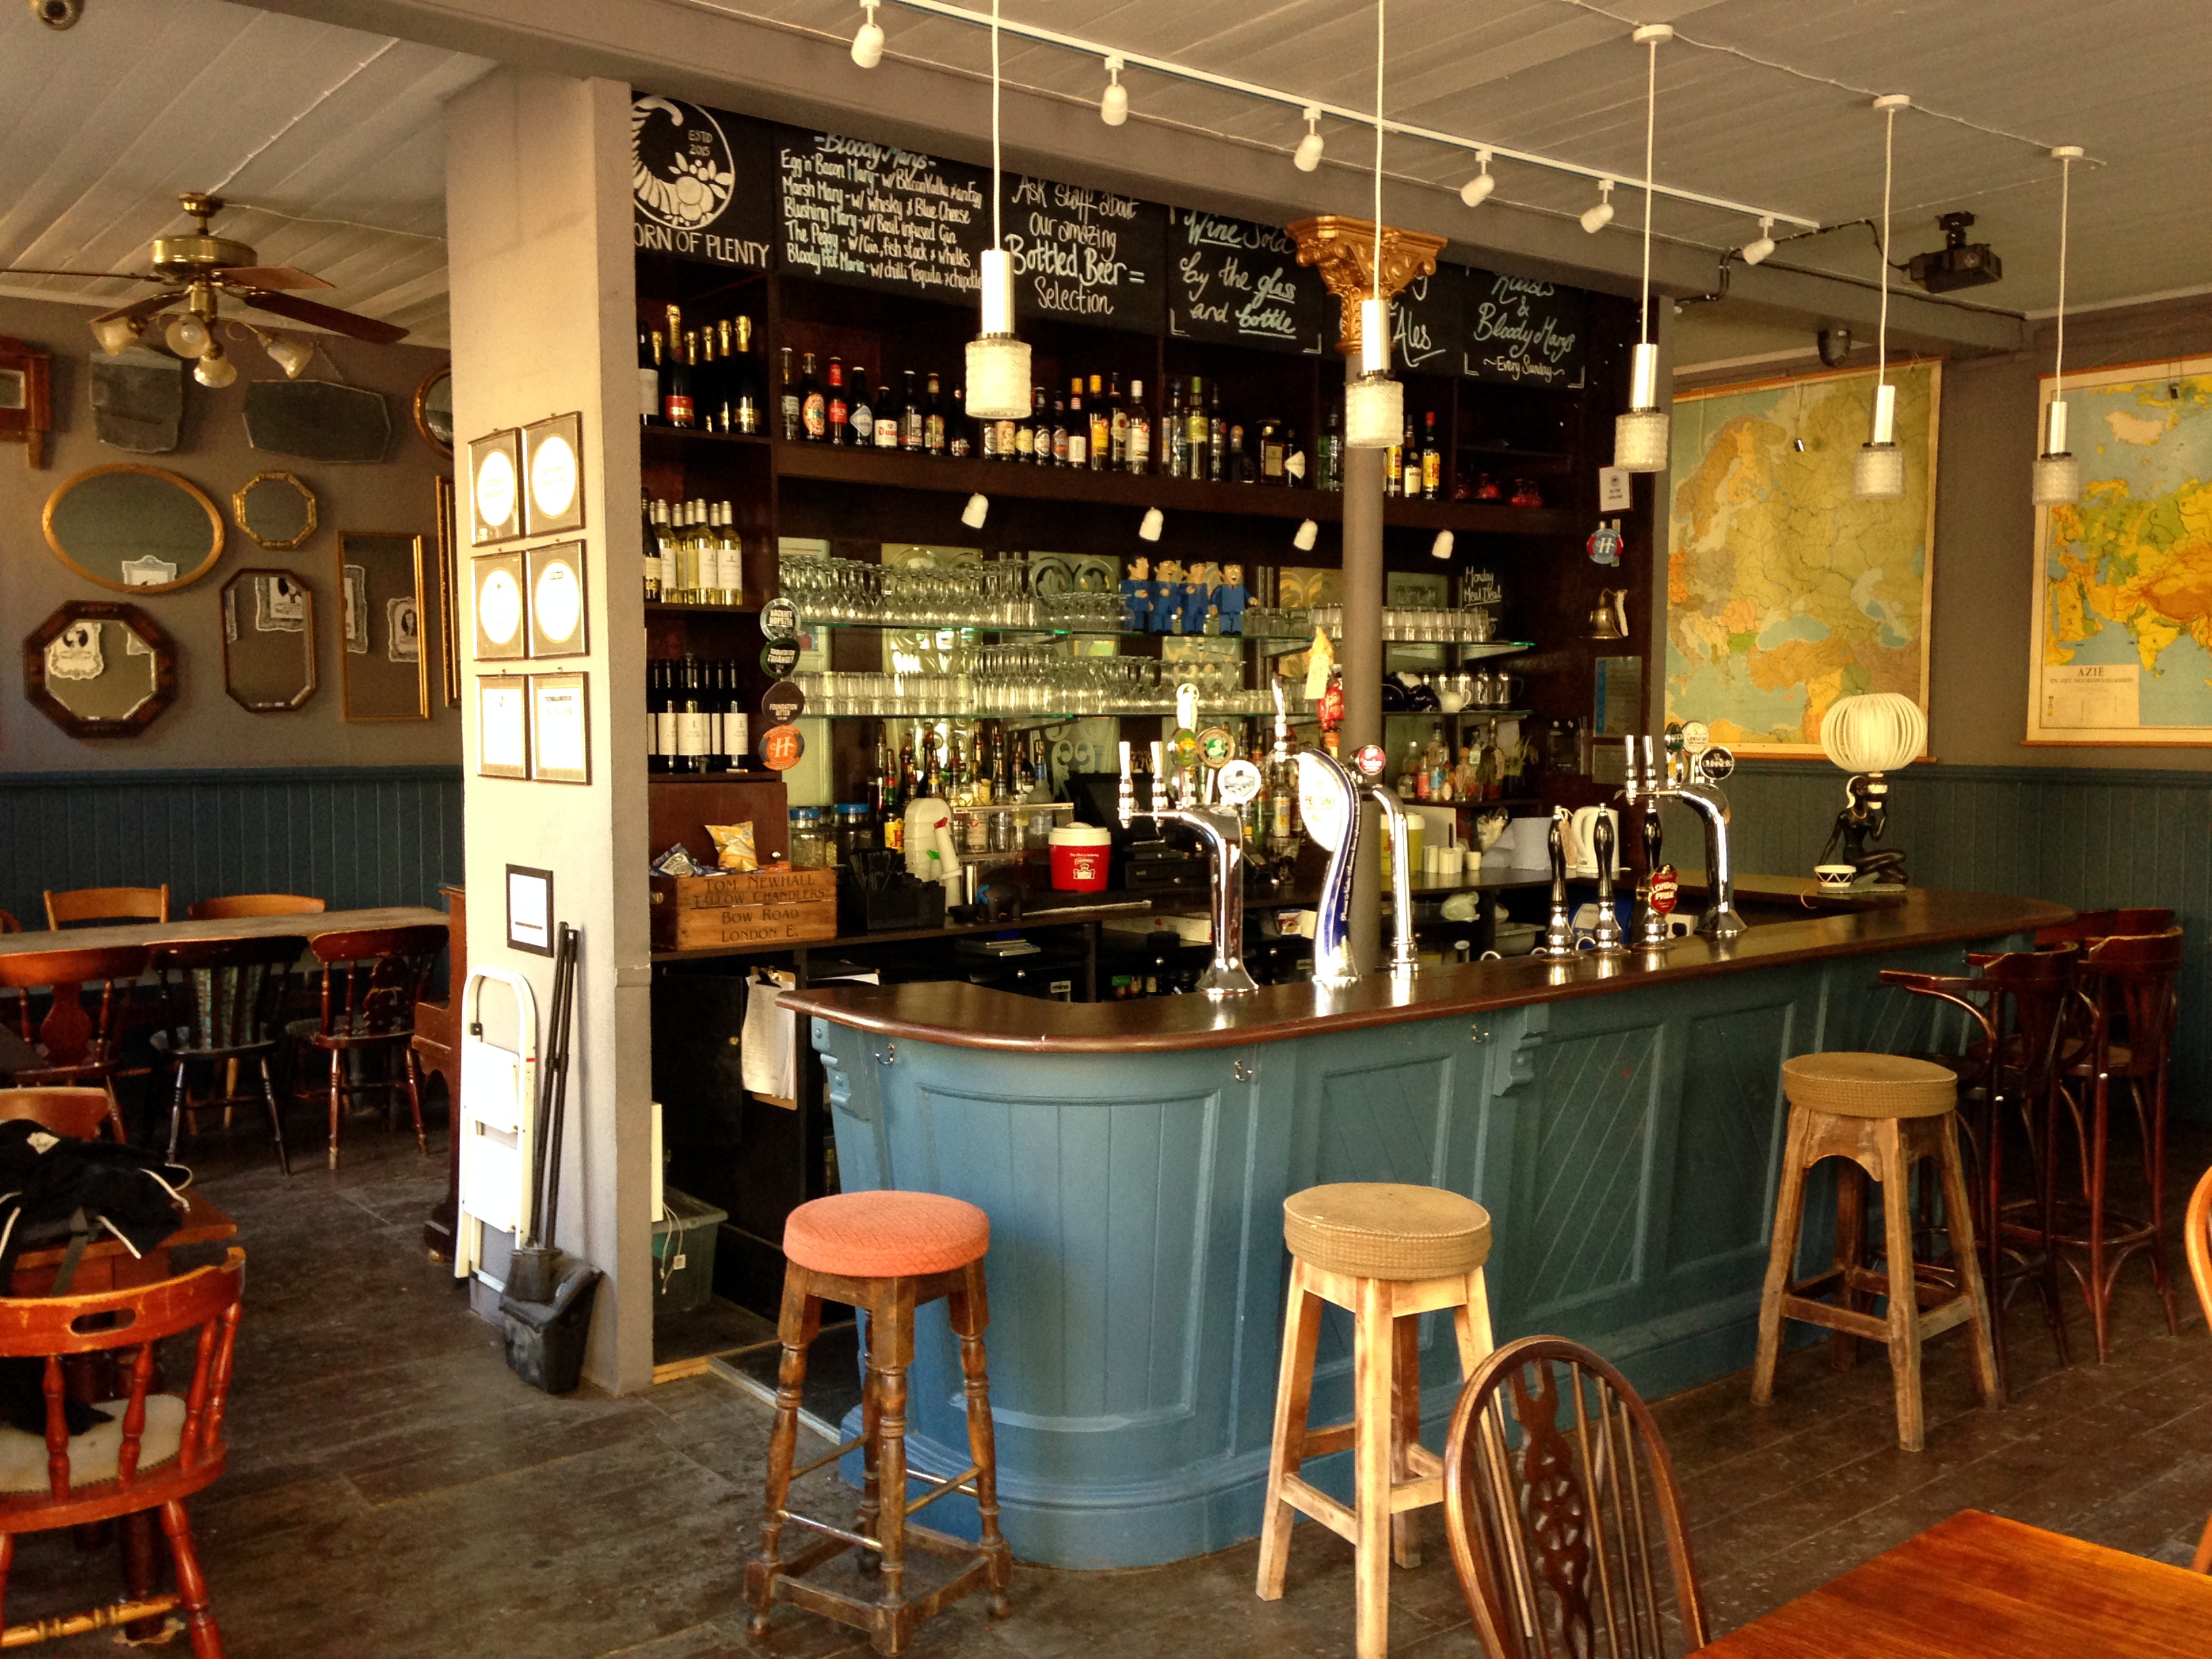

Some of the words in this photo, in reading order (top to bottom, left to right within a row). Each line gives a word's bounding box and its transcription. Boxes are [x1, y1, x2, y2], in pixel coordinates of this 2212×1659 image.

[689, 144, 710, 157] 2015
[781, 148, 802, 178] Egg
[817, 180, 844, 218] Mary
[915, 197, 938, 219] Blue
[938, 201, 971, 224] Cheese
[1054, 183, 1098, 225] Staff
[1099, 192, 1140, 220] about
[785, 219, 808, 243] The
[883, 236, 901, 258] fish
[903, 239, 928, 261] stock
[877, 213, 900, 234] Basil
[901, 221, 935, 243] infused
[939, 224, 957, 245] Gin
[1058, 220, 1117, 260] amazing
[1184, 210, 1243, 246] Wine
[676, 231, 703, 253] OF
[705, 234, 770, 268] PLENTY
[786, 242, 821, 275] Bloody
[884, 259, 908, 279] chilli
[908, 261, 943, 289] Tequila
[1004, 234, 1078, 274] Bottled
[1078, 247, 1127, 287] Beer
[1034, 277, 1114, 314] Selection
[1180, 251, 1209, 302] by
[1218, 256, 1252, 290] the
[1252, 267, 1296, 309] glass
[1189, 302, 1228, 323] and
[1235, 303, 1296, 333] bottle
[1473, 302, 1534, 359] Bloody
[1534, 316, 1576, 363] Marys
[1393, 306, 1432, 367] Ales
[1464, 586, 1481, 603] Meal
[1482, 585, 1502, 602] Deal
[1466, 566, 1494, 591] Monday
[1702, 758, 1733, 768] GUINNESS
[703, 879, 737, 893] TOM
[748, 874, 815, 889] NEWHALL
[753, 889, 825, 901] CHANDLERS
[1652, 882, 1678, 893] LONDON
[1655, 892, 1674, 900] PRIDE
[722, 912, 753, 924] BOW
[762, 909, 799, 921] ROAD
[721, 928, 777, 943] LONDON
[786, 924, 798, 937] E.
